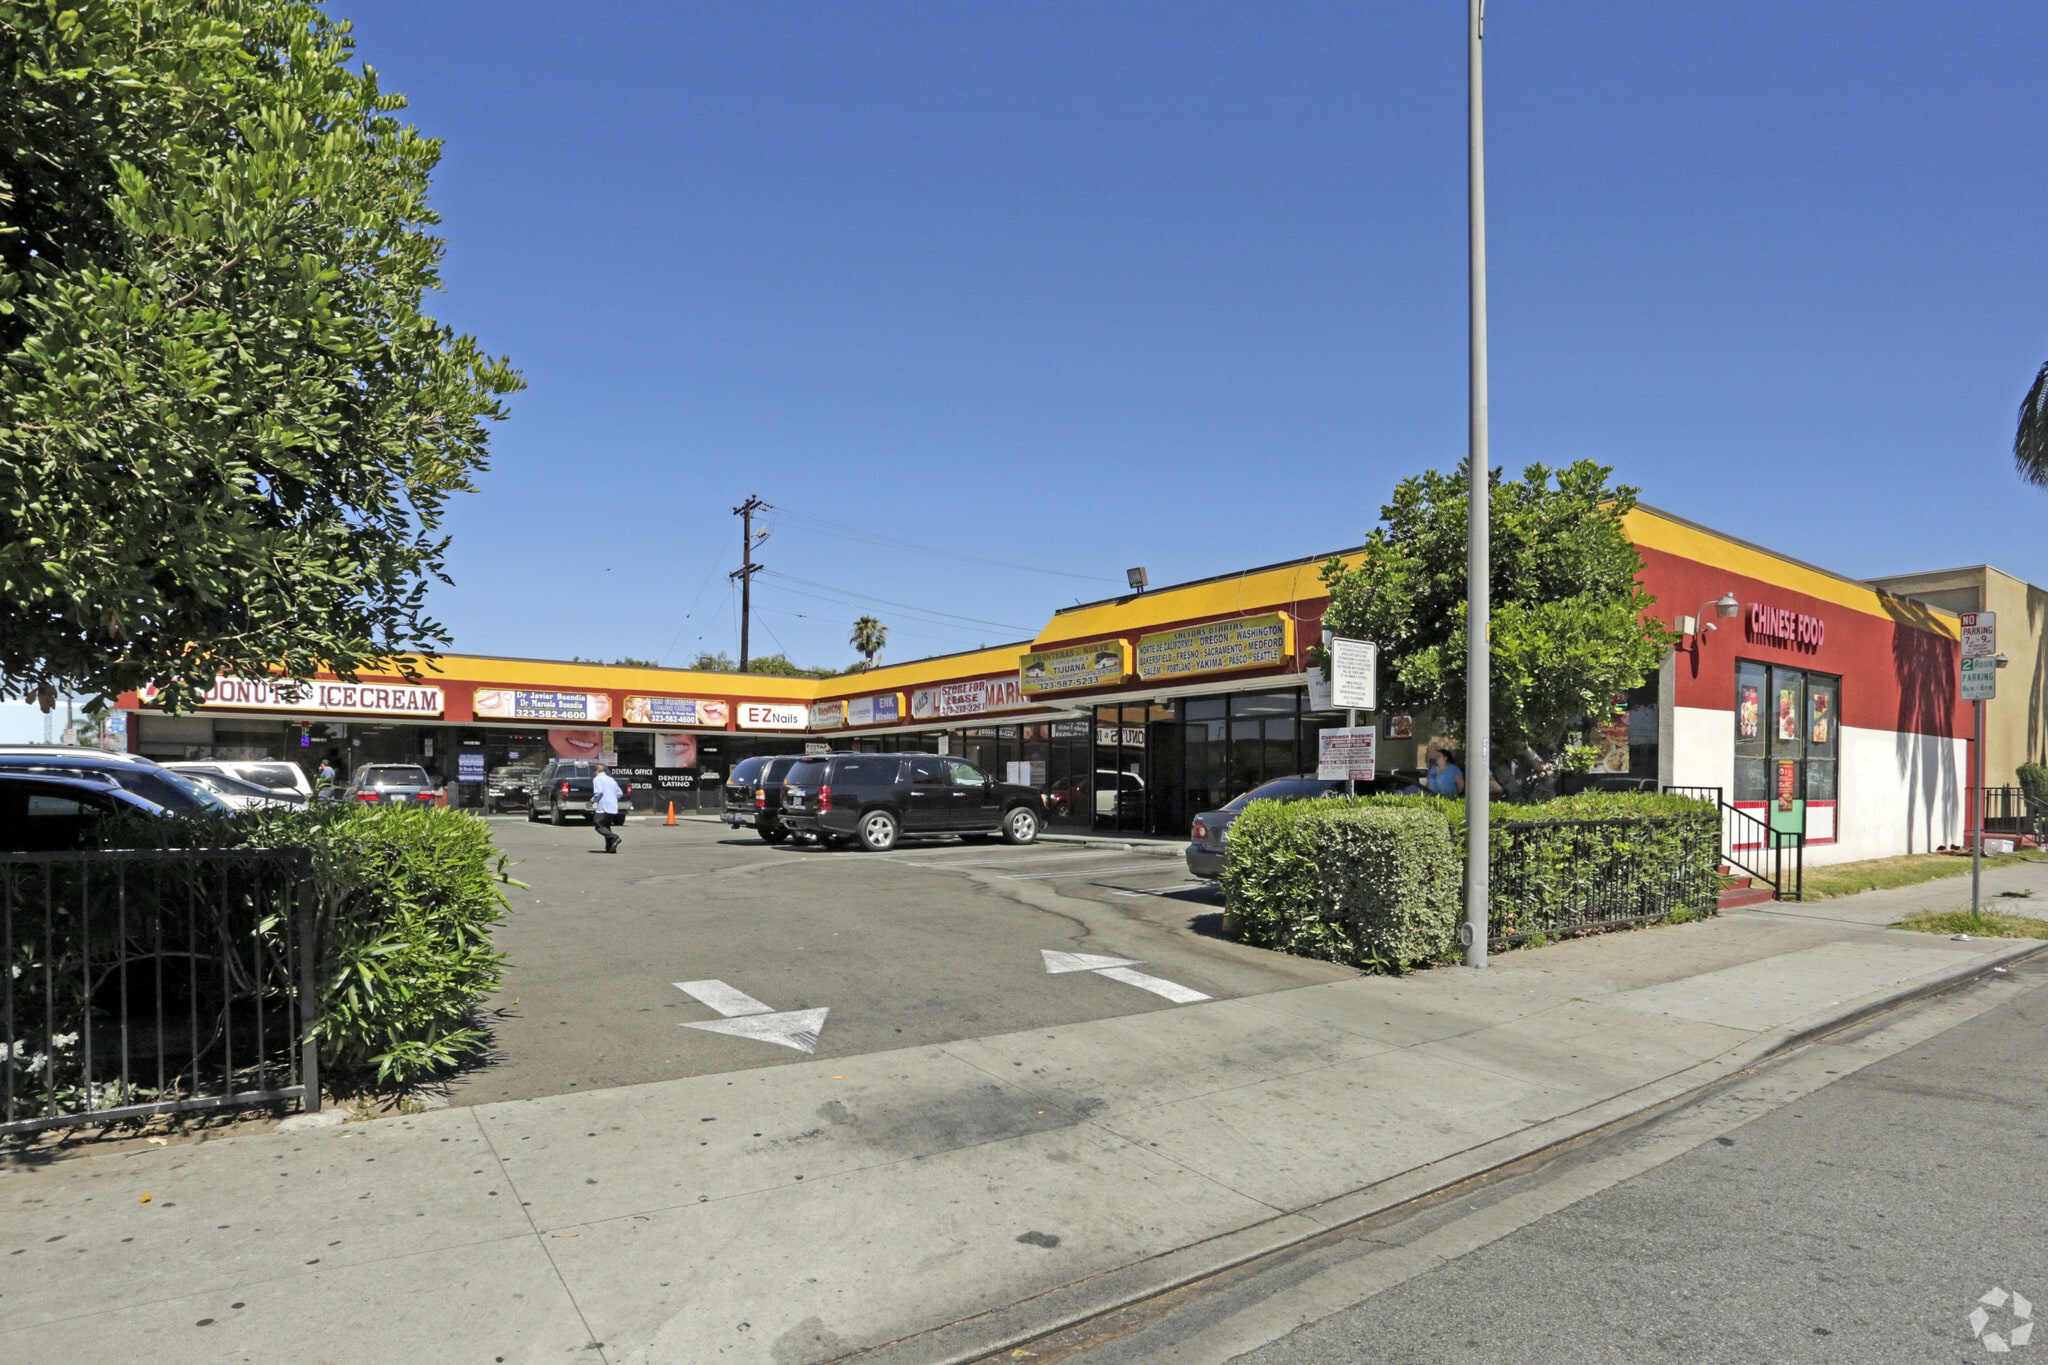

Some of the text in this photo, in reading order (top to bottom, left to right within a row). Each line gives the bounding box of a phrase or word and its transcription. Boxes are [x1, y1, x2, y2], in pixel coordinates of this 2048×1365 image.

[1752, 602, 1825, 646] CHINESE FOOD
[1963, 615, 1975, 626] NO
[1174, 629, 1206, 640] SALIDAS
[1963, 626, 1993, 636] PARKING
[1140, 623, 1283, 654] NORTE DE CALIFORNIA OREGON WASHINGTON
[1083, 643, 1110, 655] NORTE
[1140, 637, 1283, 666] BAKERSFIELD FRESNO SACRAMENTO MEDFORD
[1143, 650, 1279, 676] SALEM PORTLAND YAKIMA PASCO SEATTLE
[1962, 659, 1993, 669] 2 HOUR
[1053, 663, 1086, 675] TIJUANA
[1962, 672, 1994, 682] PARKING
[942, 681, 985, 695] STORE FOR
[1039, 676, 1099, 690] 323-587-5233
[516, 691, 527, 699] Dr
[530, 692, 553, 700] Javier
[947, 693, 979, 705] LEASE
[520, 699, 529, 707] Dr
[879, 696, 895, 709] ENK
[516, 709, 586, 719] 323-582-4600
[651, 715, 695, 723] 323-582-4600
[773, 713, 798, 724] Nails
[876, 711, 898, 721] Wireless
[611, 768, 653, 776] DENTAL OFFICE
